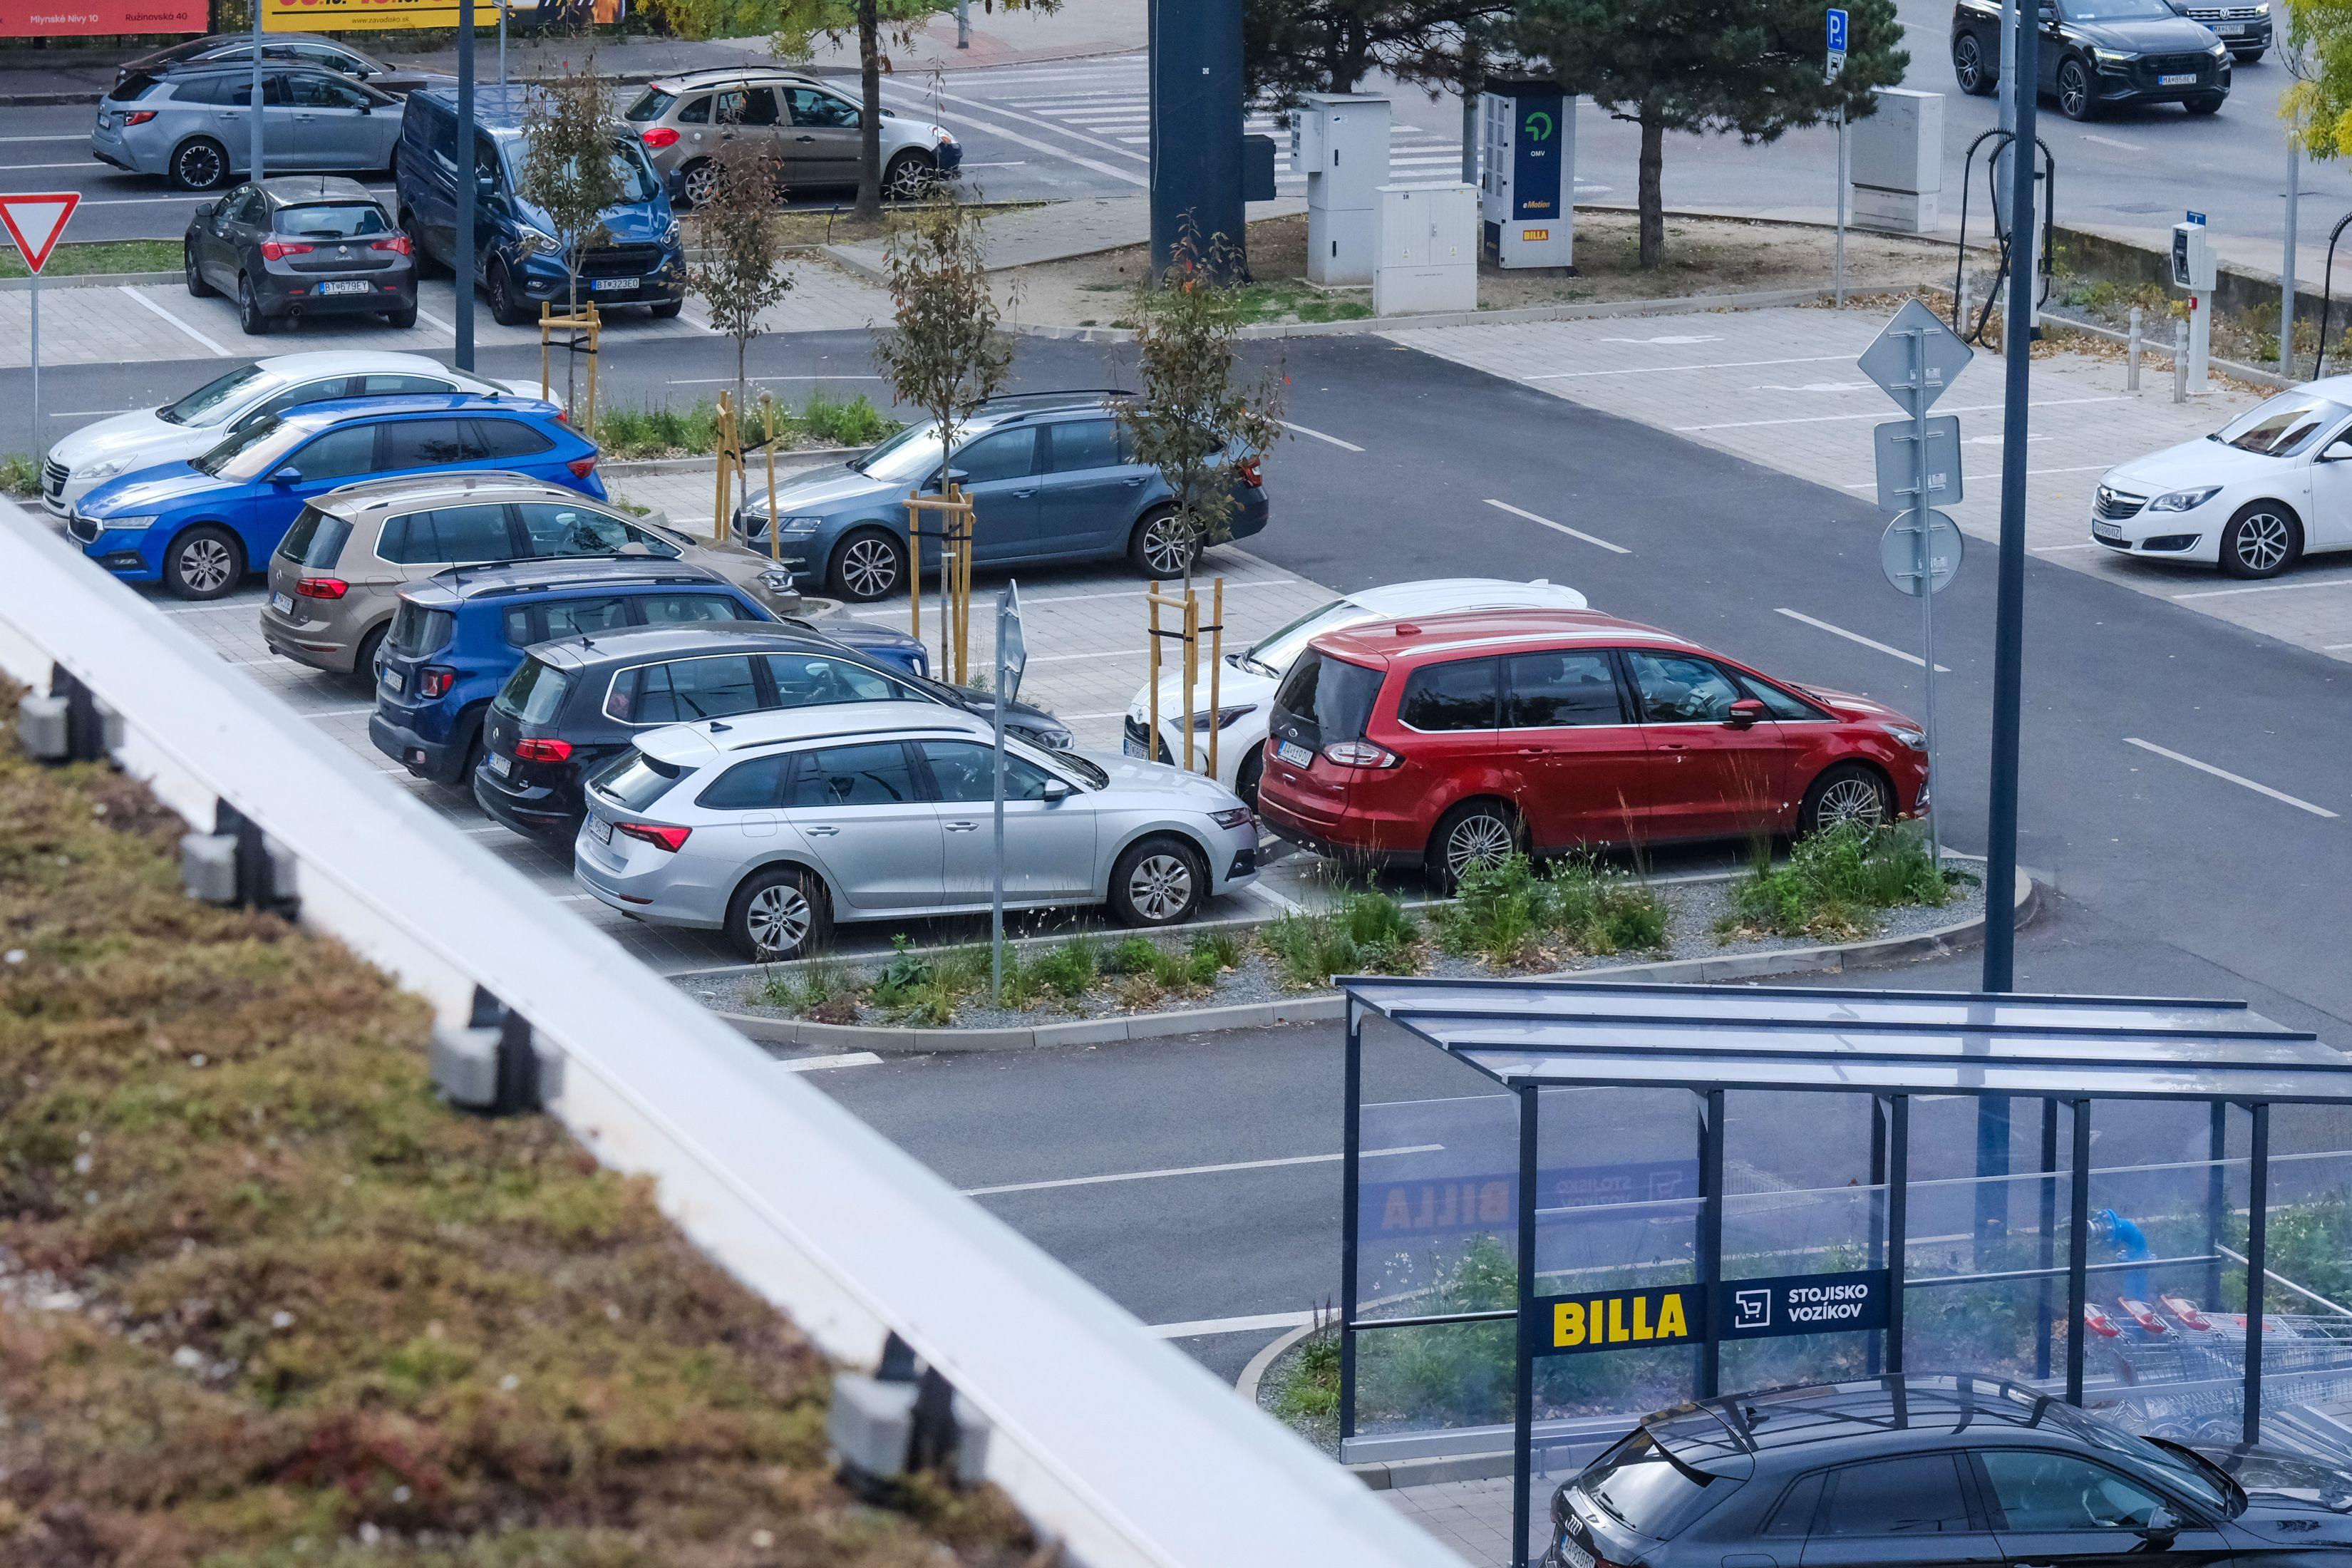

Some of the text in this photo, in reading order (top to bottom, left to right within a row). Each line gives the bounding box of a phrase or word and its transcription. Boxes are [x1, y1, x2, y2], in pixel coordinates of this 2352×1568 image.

[31, 14, 66, 25] Mlynské
[68, 14, 86, 24] Nivy
[125, 12, 174, 21] Ružinovská
[1830, 15, 1840, 44] P
[1524, 231, 1547, 240] BILLA
[1788, 1284, 1868, 1303] STOJISKO
[1553, 1294, 1687, 1347] BILLA
[1788, 1301, 1862, 1321] VOZÍKOV
